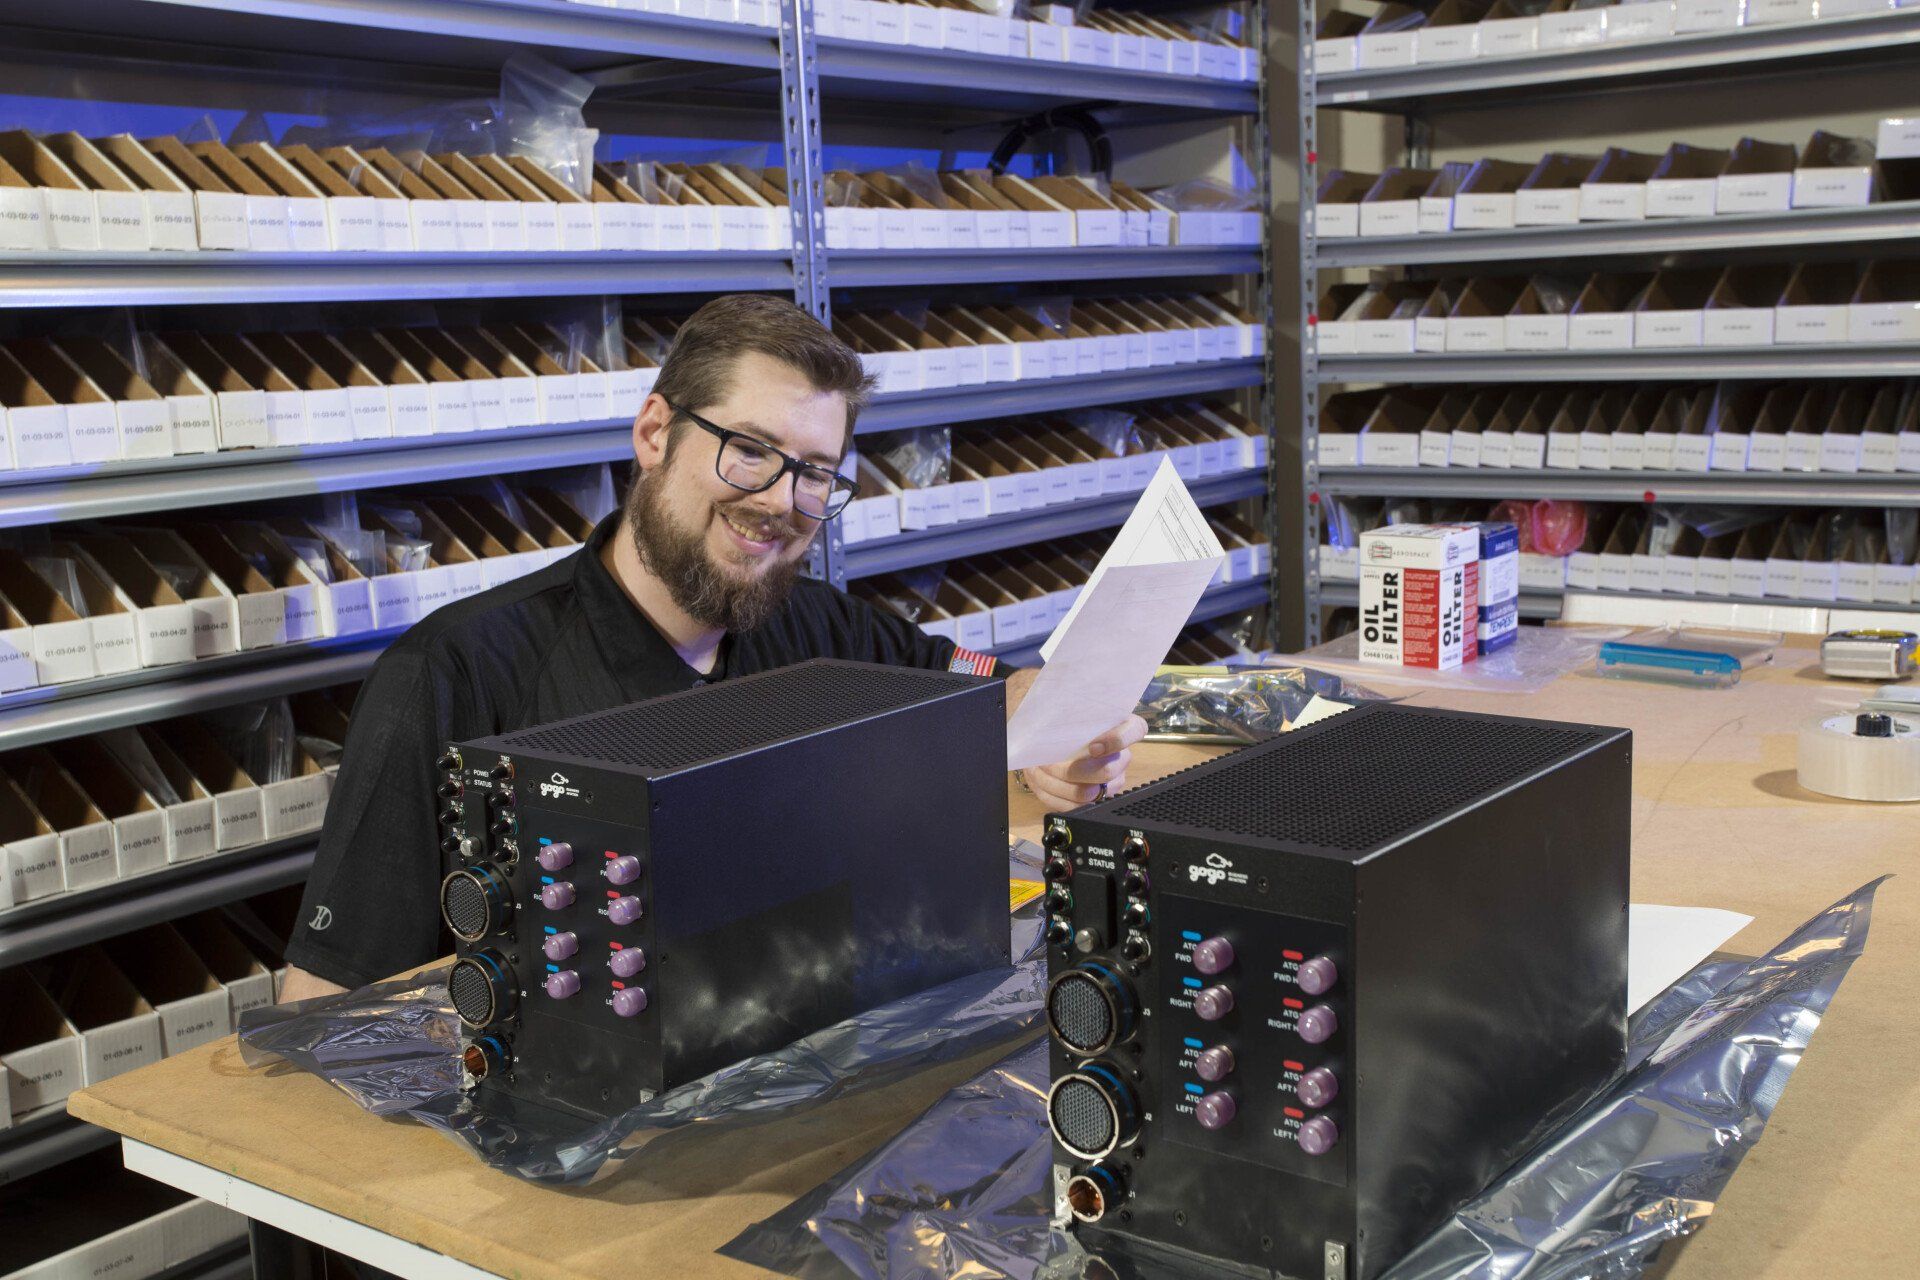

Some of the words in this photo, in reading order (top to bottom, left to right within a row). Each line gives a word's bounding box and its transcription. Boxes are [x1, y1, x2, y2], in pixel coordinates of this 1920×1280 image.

[0, 211, 39, 220] 1-03-02-20
[1382, 572, 1399, 644] FILTER
[1453, 571, 1462, 644] FILTER
[1364, 605, 1379, 642] OIL
[1443, 607, 1452, 647] OIL
[474, 779, 493, 788] STATUS
[540, 782, 565, 799] gogo
[1088, 846, 1114, 857] POWER
[1088, 858, 1115, 870] STATUS
[1189, 865, 1226, 885] gogo
[1175, 953, 1192, 963] FWD
[1273, 972, 1292, 983] FWD
[1169, 998, 1192, 1009] RIGHT
[1143, 1008, 1150, 1016] J3
[1267, 1018, 1292, 1030] RIGHT
[1179, 1059, 1193, 1069] AFT
[1277, 1082, 1292, 1092] AFT
[1176, 1104, 1193, 1115] LEFT
[1144, 1113, 1152, 1121] J2
[1273, 1128, 1292, 1139] LEFT
[1128, 1191, 1136, 1199] J1
